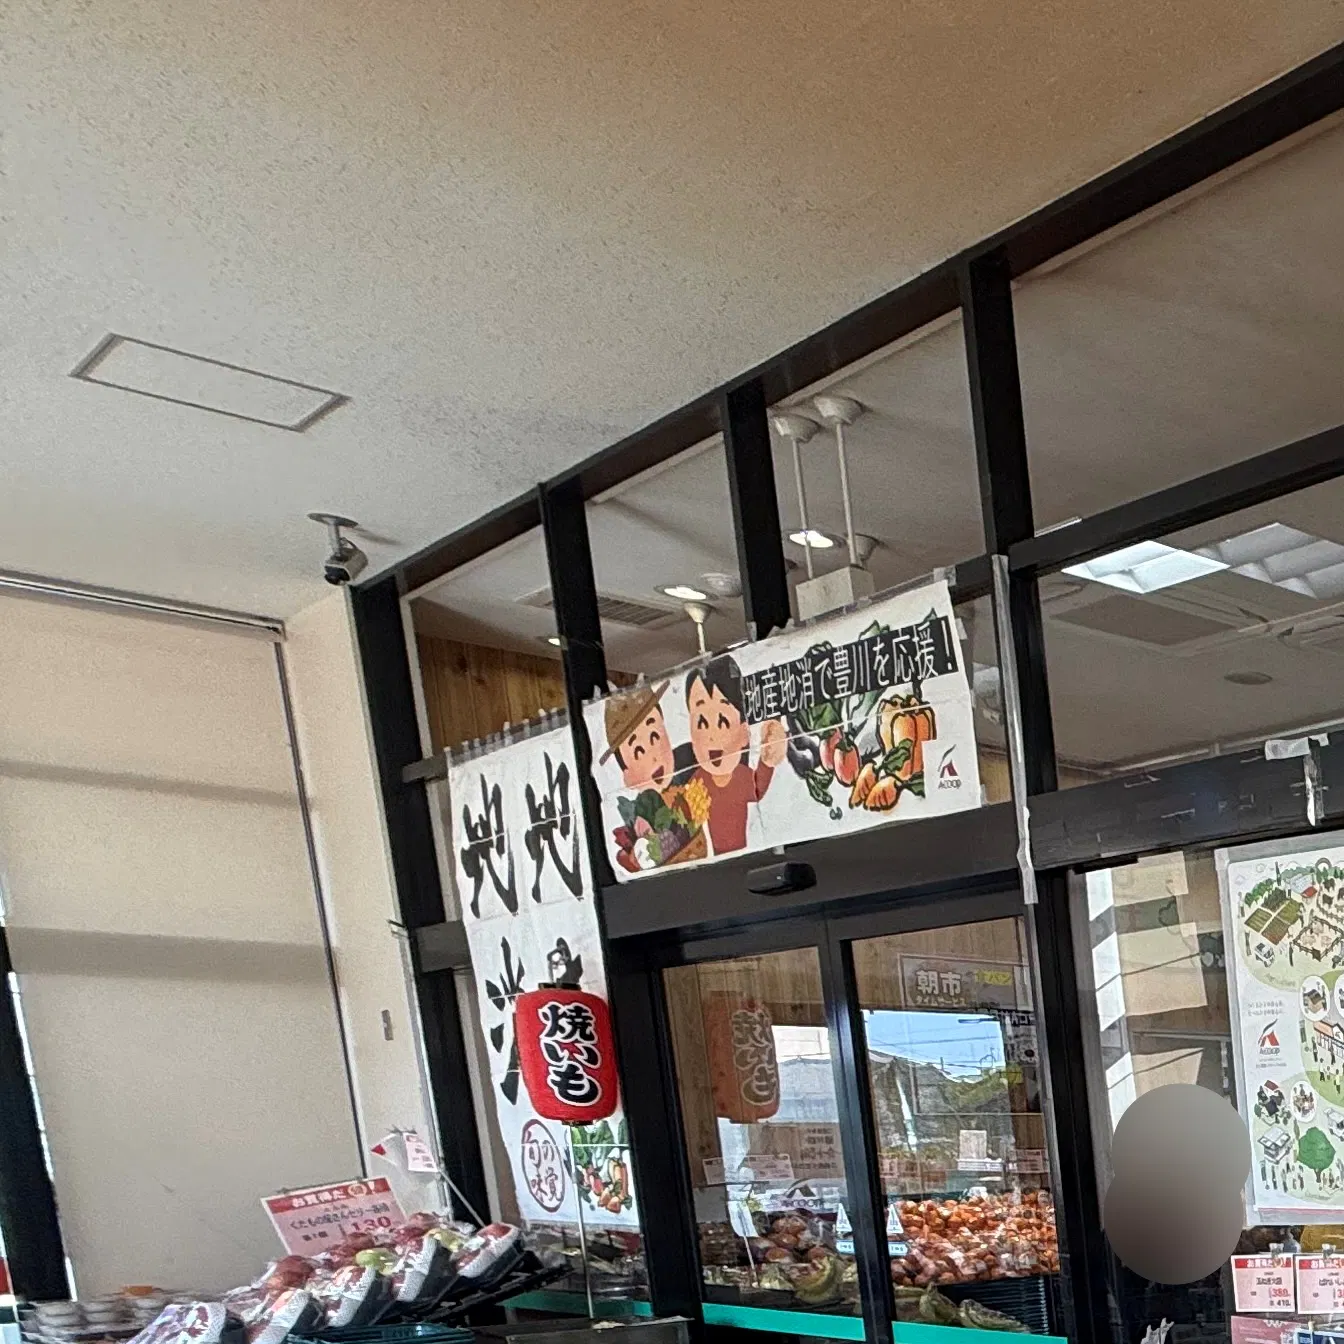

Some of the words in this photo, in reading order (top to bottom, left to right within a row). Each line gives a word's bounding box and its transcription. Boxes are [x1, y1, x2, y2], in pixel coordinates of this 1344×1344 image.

[744, 619, 956, 724] 地産地消で豊川を応援！
[916, 969, 963, 997] 朝市
[540, 1002, 602, 1107] 焼いも
